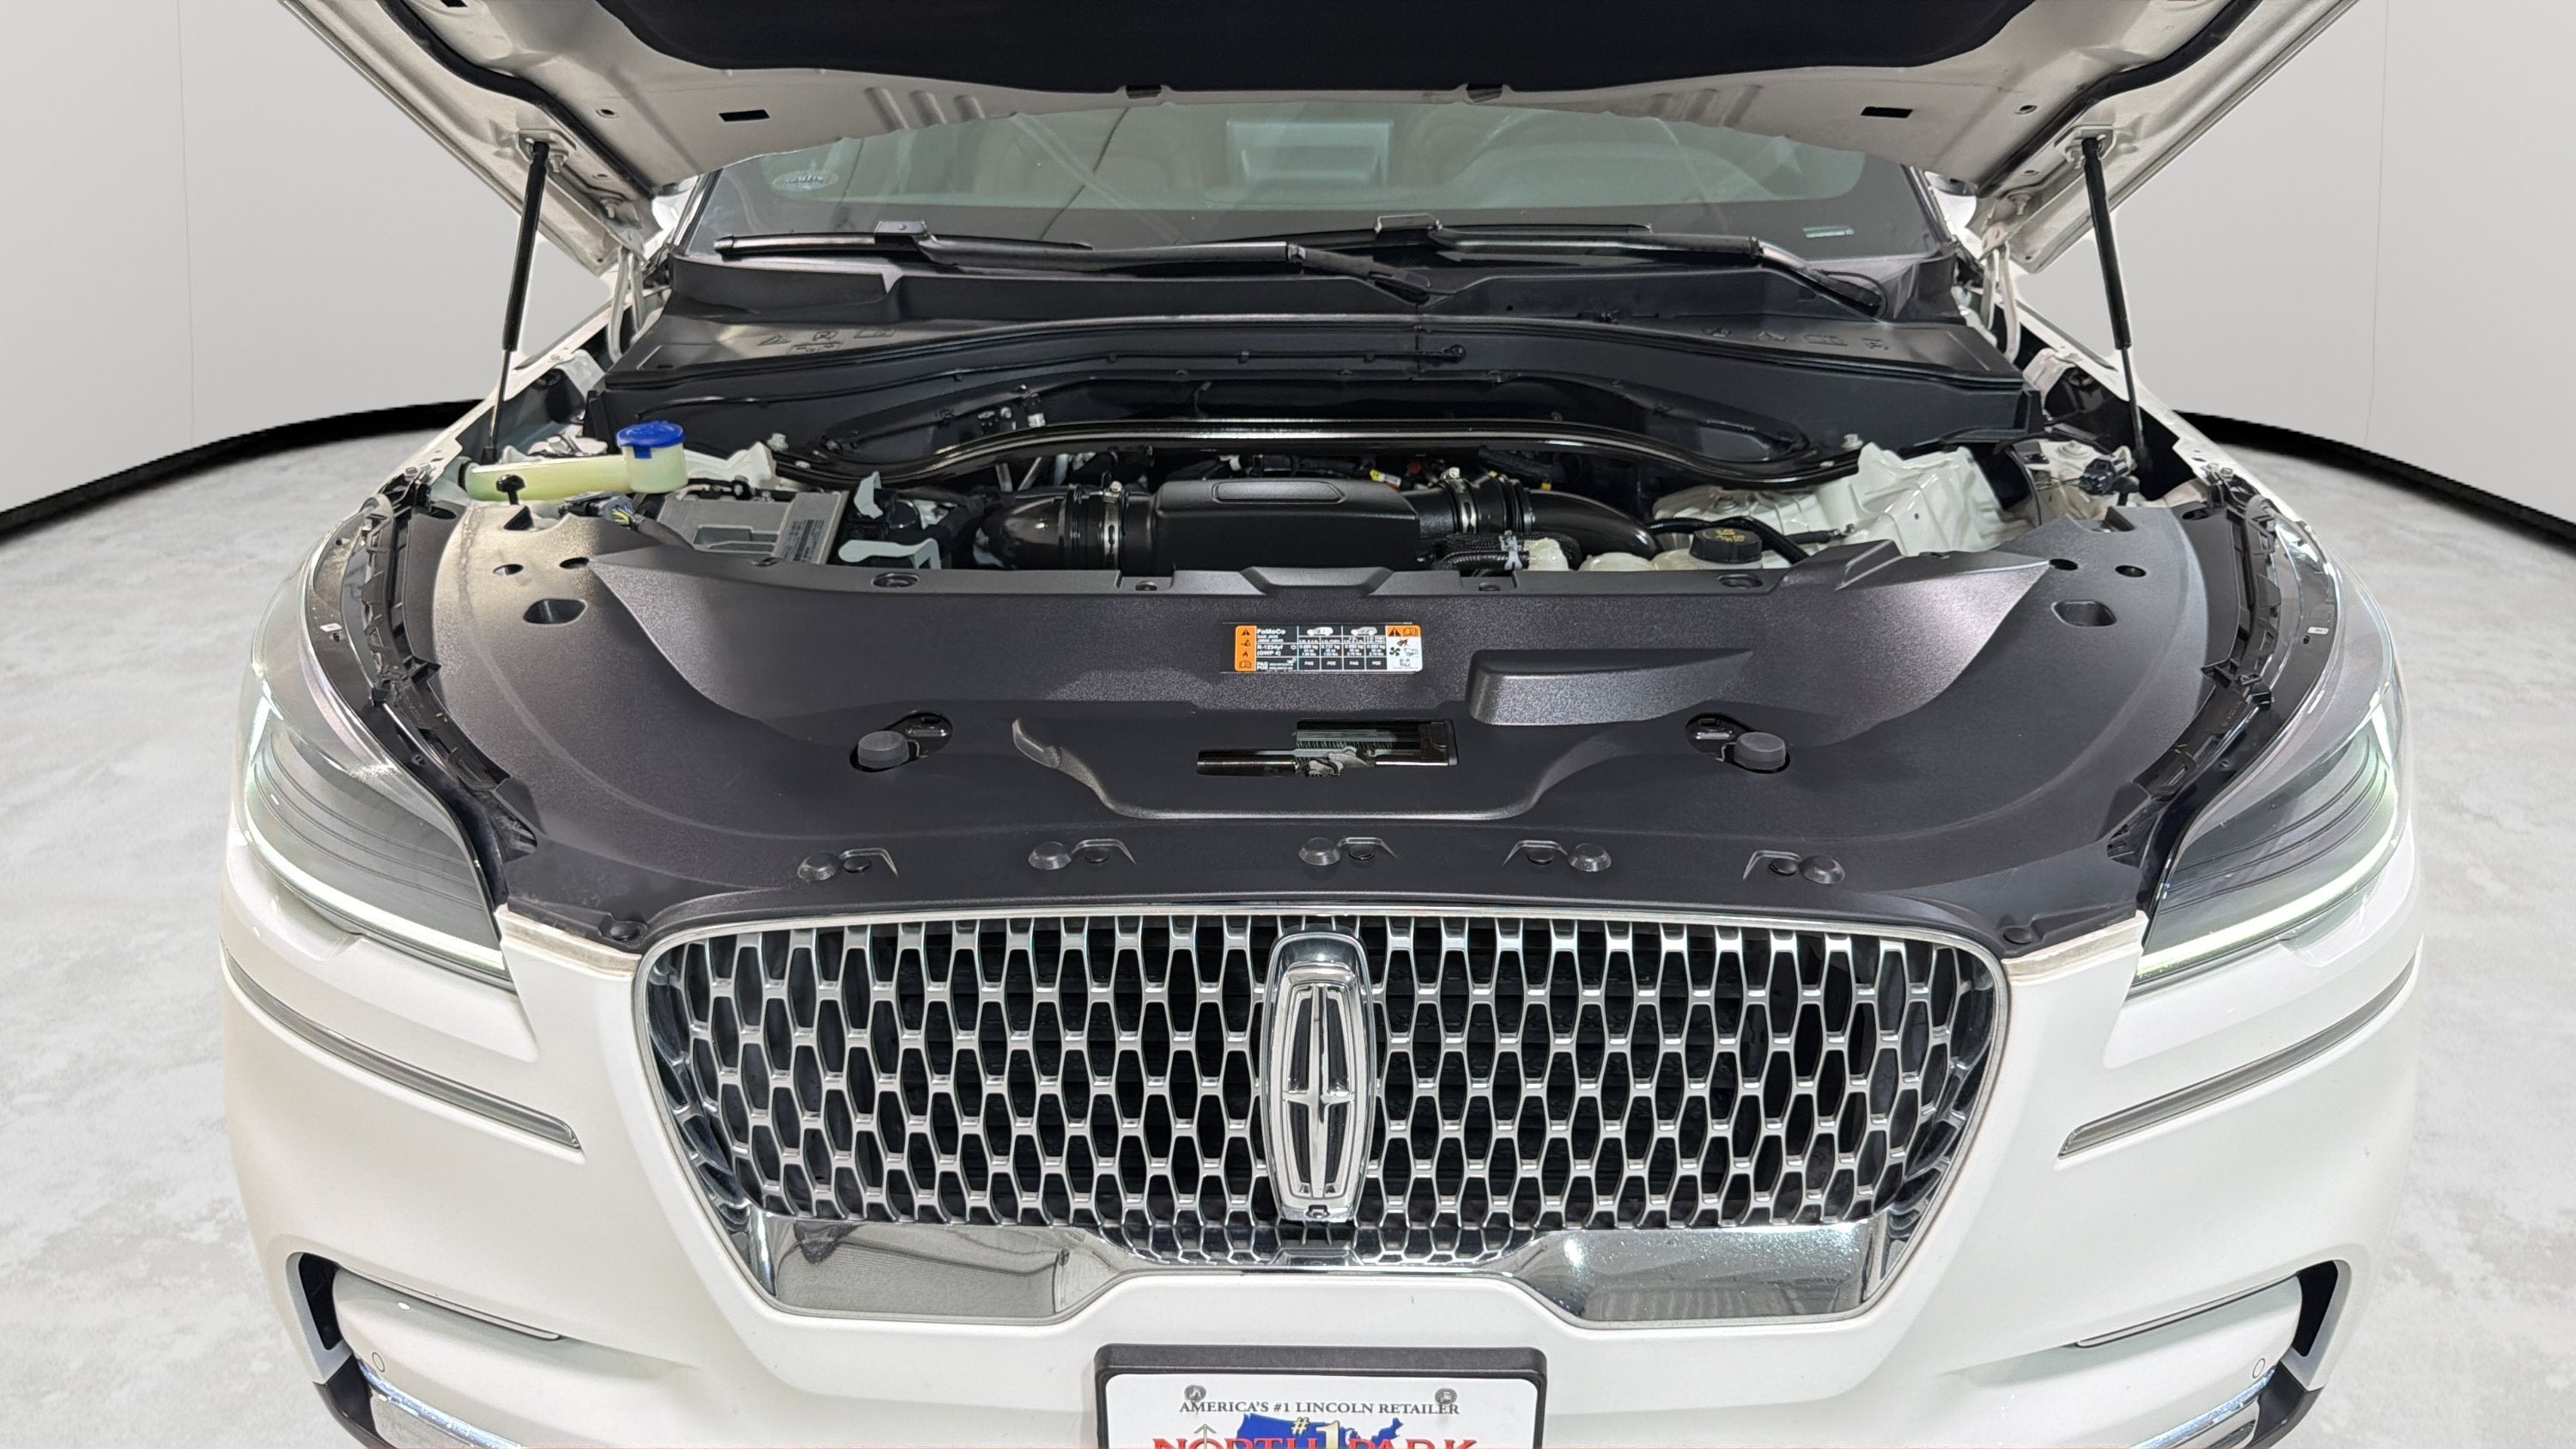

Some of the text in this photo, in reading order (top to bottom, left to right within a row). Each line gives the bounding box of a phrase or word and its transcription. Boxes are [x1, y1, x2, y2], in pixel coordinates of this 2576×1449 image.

[1180, 1401, 1461, 1415] AMERICA'S #1 LINCOLN RETAILER
